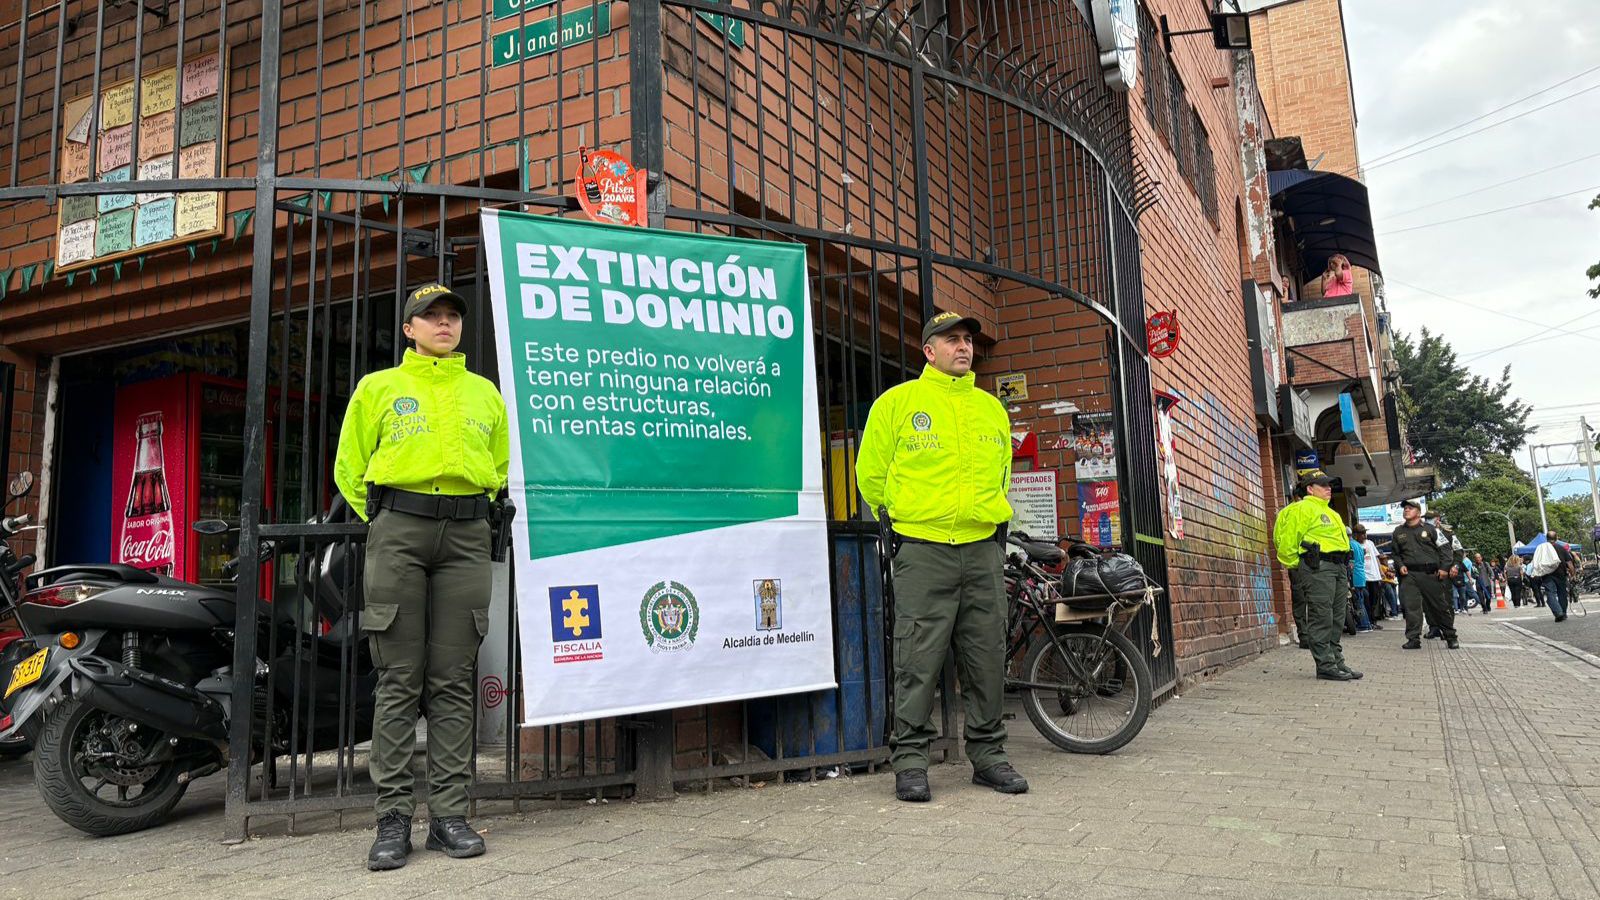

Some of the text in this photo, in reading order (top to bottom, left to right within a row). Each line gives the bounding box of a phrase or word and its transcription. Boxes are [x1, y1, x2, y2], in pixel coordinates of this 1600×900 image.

[600, 179, 635, 194] Pilsen
[516, 242, 777, 300] EXTINCIÓN
[519, 283, 794, 339] DE DOMINIO
[524, 341, 781, 377] Este predio no volverá a
[526, 365, 771, 398] tener ninguna relación
[529, 394, 715, 418] con estructuras,
[392, 415, 426, 430] SIJIN
[533, 415, 752, 441] ni rentas criminales.
[391, 425, 434, 444] MEVAL
[909, 433, 938, 442] SIJIN
[906, 441, 944, 452] MEVAL
[1010, 475, 1052, 484] ROPIEDADES
[127, 520, 144, 528] SABOR
[723, 631, 814, 648] Alcaldía de Medellín
